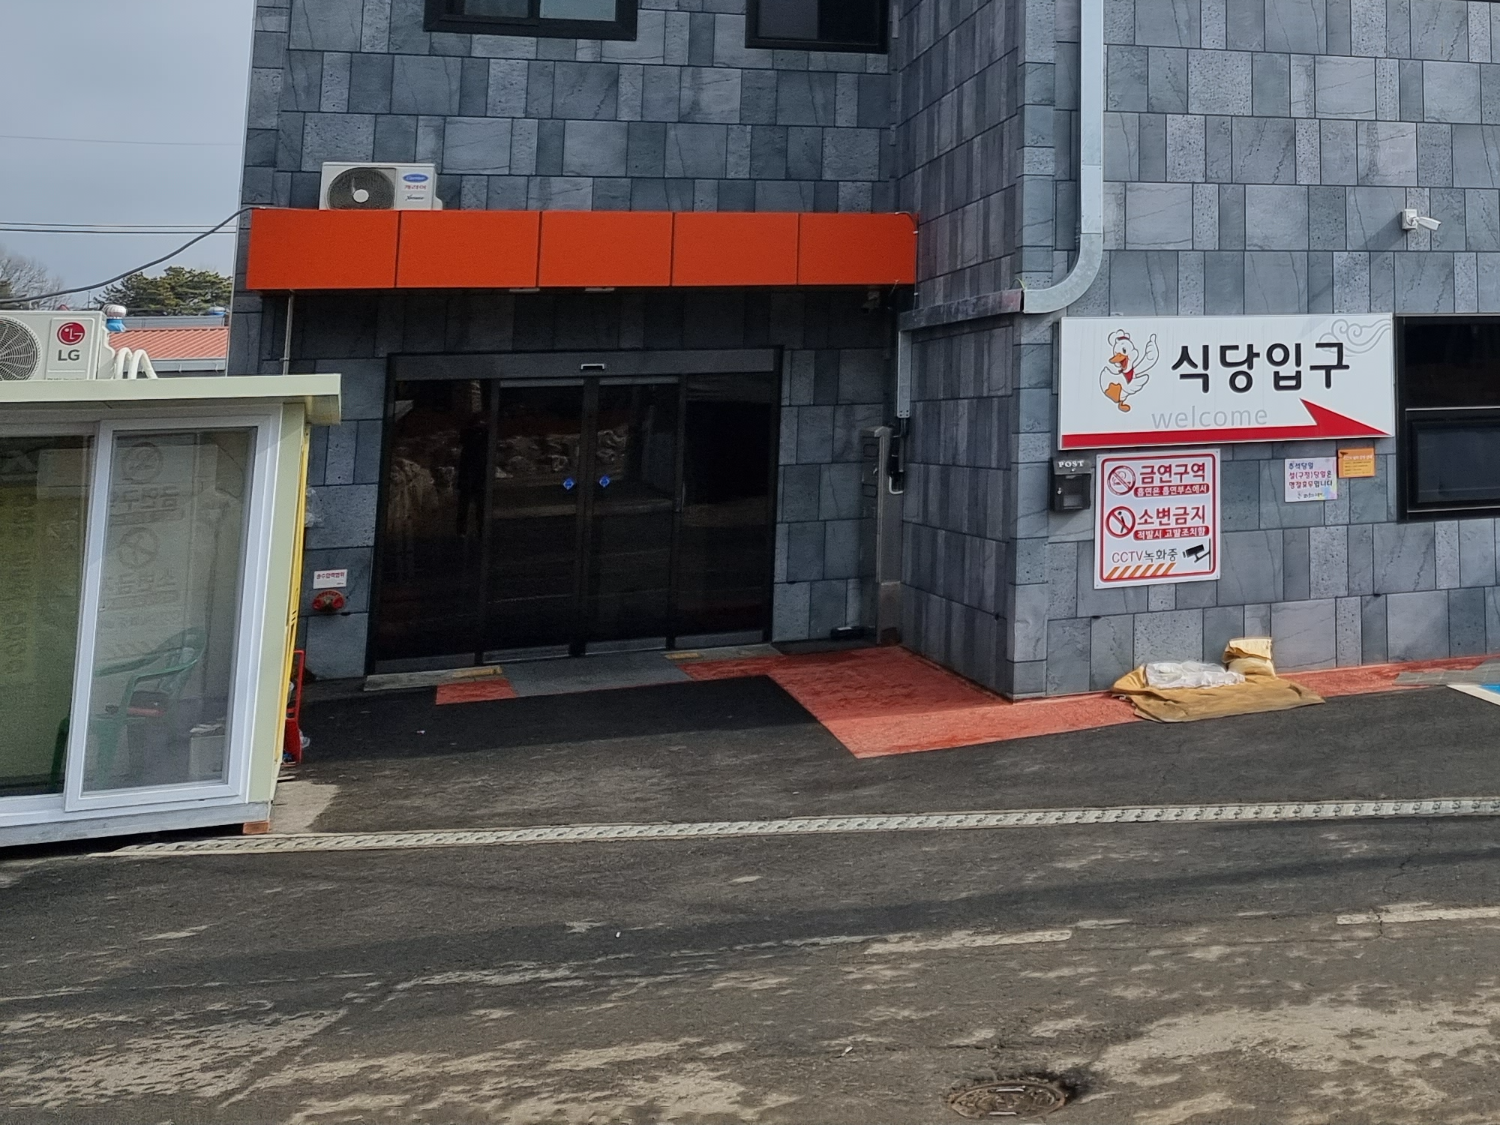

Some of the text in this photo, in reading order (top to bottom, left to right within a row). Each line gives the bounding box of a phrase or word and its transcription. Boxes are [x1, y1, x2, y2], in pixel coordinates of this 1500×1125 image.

[58, 349, 80, 362] LG
[1171, 342, 1350, 393] 식당입구
[1152, 405, 1268, 429] welcome
[1058, 460, 1085, 468] POST
[1140, 462, 1206, 485] 금연구역
[1138, 505, 1206, 526] 소변금지
[1137, 527, 1206, 540] 적발시 고발조치함
